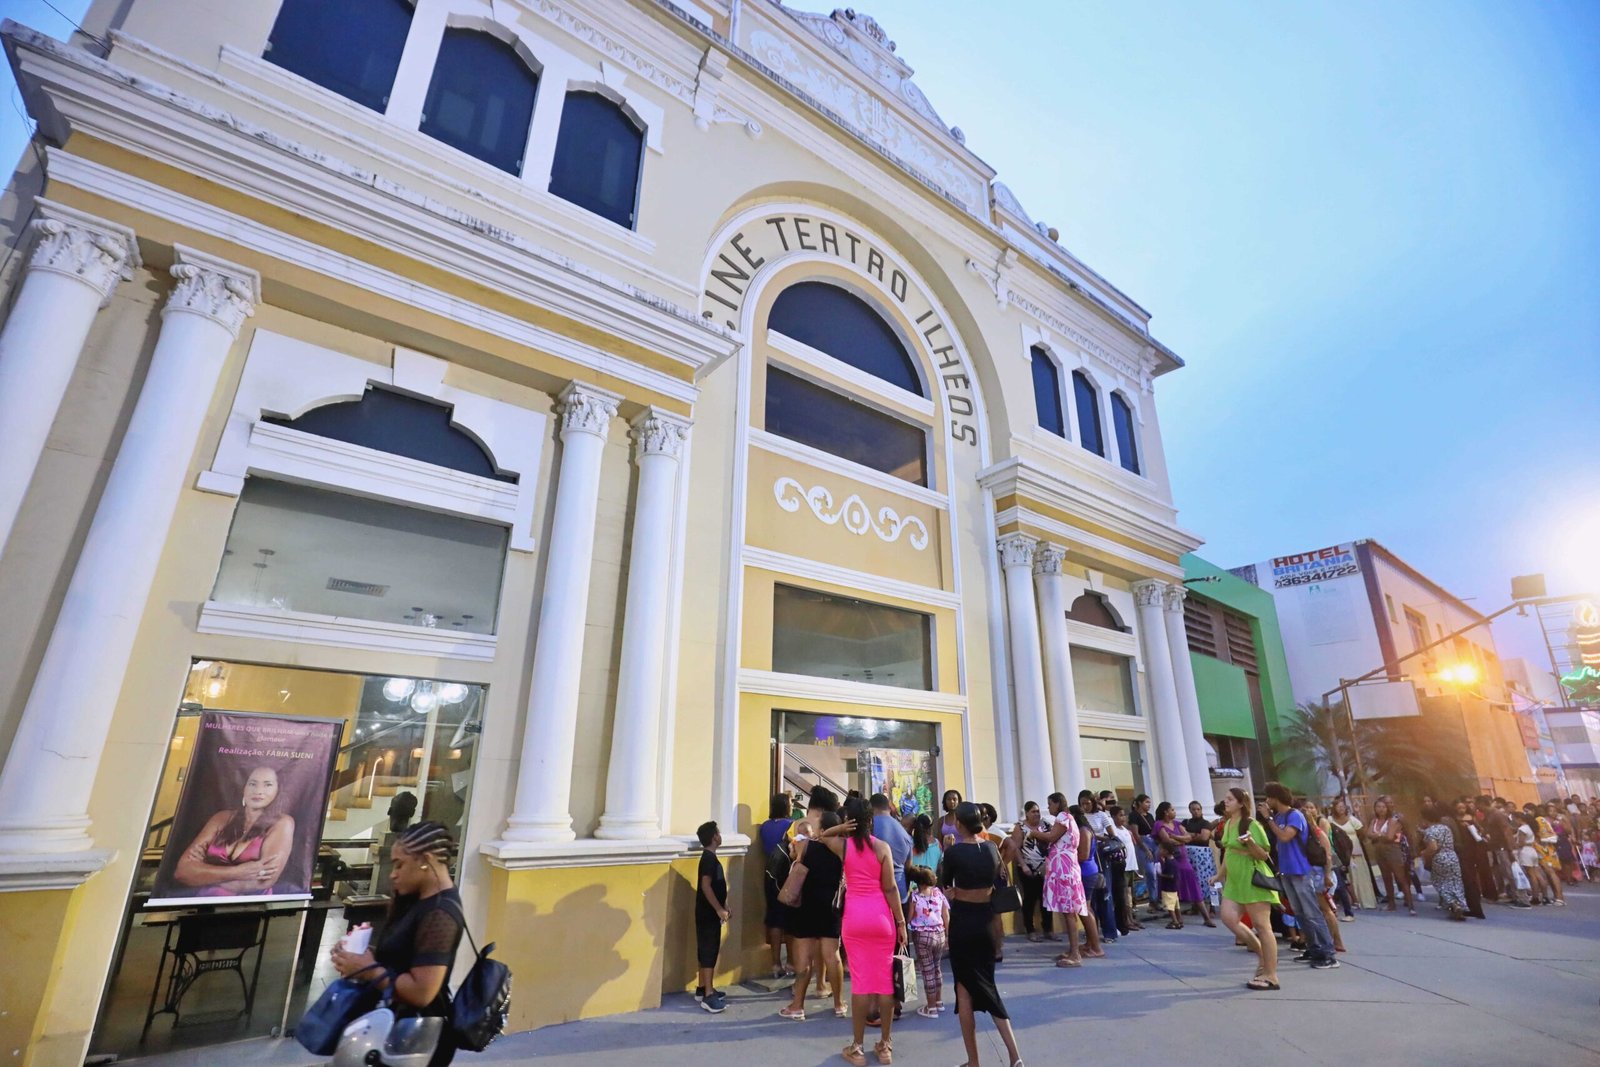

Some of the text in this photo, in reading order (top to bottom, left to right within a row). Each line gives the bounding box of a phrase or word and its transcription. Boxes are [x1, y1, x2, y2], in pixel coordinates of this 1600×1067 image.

[766, 217, 908, 303] TEATRO
[1273, 554, 1354, 576] BRITANIA
[1274, 546, 1350, 568] HOTEL
[1282, 565, 1358, 587] 36341722
[204, 722, 244, 731] MULHERES
[219, 746, 264, 757] Realização:
[290, 751, 314, 759] SUENI
